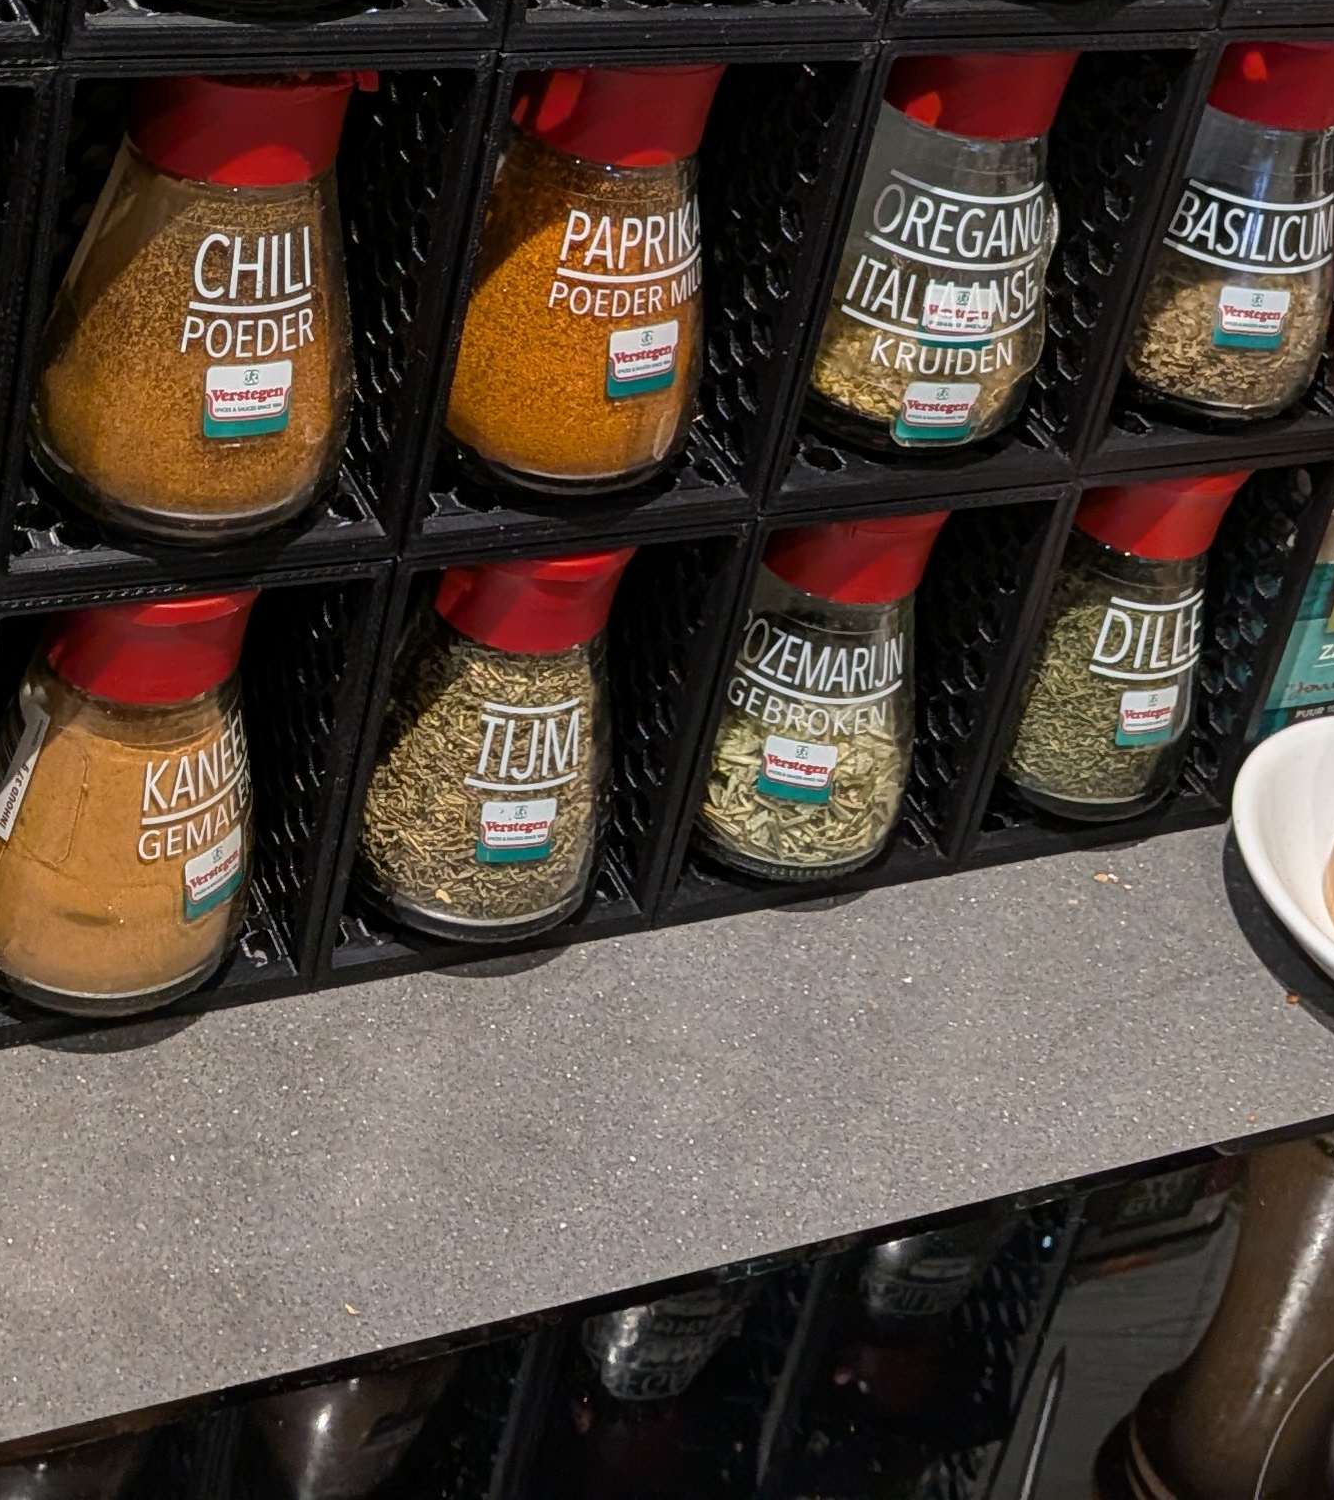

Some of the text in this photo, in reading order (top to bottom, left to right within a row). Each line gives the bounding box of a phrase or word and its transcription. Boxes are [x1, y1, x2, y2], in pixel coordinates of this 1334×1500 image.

[560, 193, 702, 270] PAPRIKA
[873, 183, 1044, 259] OREGANO
[1168, 189, 1334, 263] BASILICUM
[193, 226, 312, 300] CHILI
[548, 257, 703, 318] POEDER MILD
[180, 307, 315, 359] POEDER
[1223, 304, 1281, 323] Verstegen
[613, 344, 673, 365] Verstegen
[870, 334, 1013, 376] KRUIDEN
[210, 386, 284, 403] Verstegen
[907, 398, 968, 415] Verstegen
[1092, 600, 1204, 669] DILLE
[727, 676, 888, 737] GEBROKEN
[142, 709, 248, 812] KANEEL
[476, 709, 581, 780] TIJM
[767, 753, 828, 776] Verstegen
[0, 786, 20, 830] INHOUD
[138, 758, 252, 861] GEMALEN
[485, 819, 548, 834] Verstegen
[188, 848, 240, 890] Verstegen
